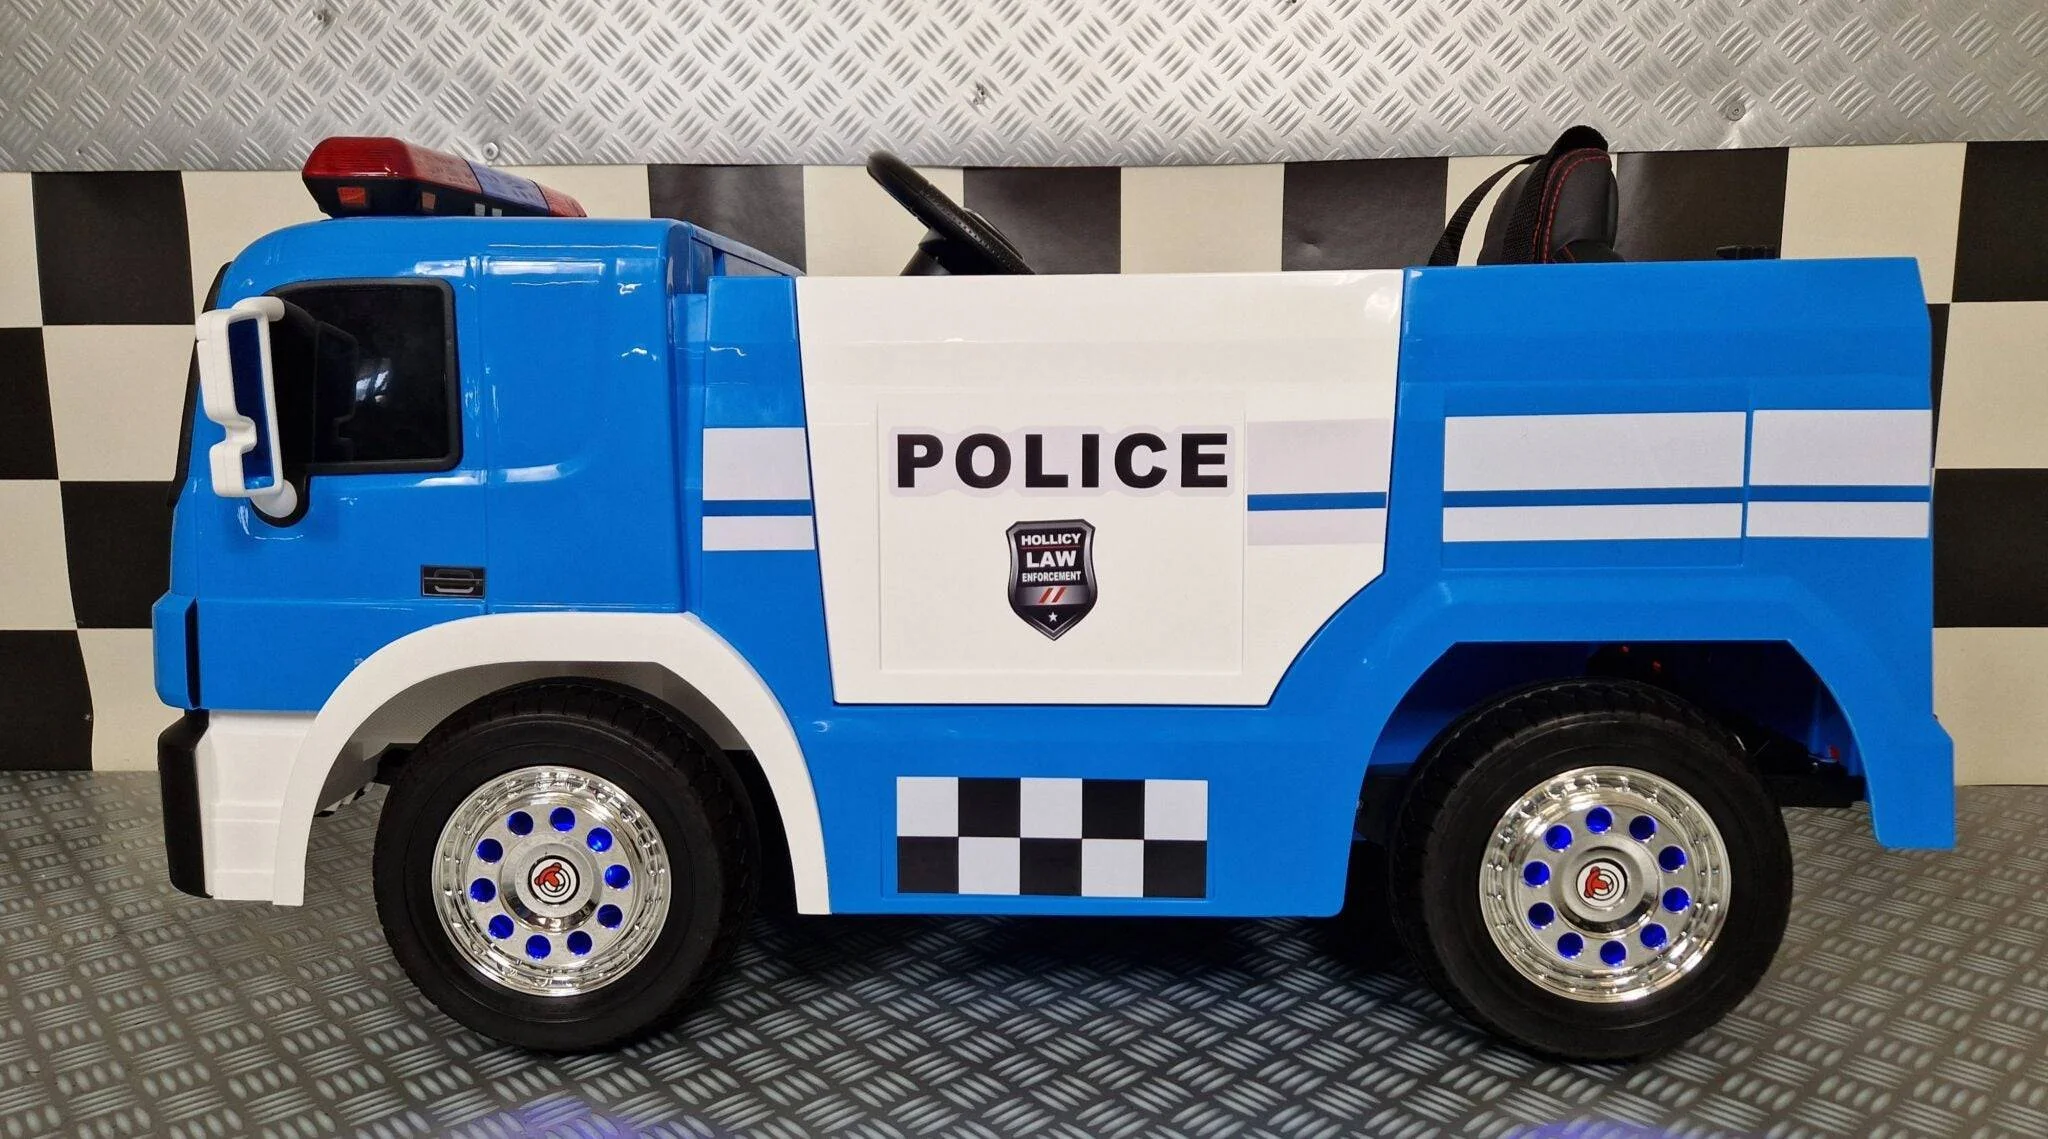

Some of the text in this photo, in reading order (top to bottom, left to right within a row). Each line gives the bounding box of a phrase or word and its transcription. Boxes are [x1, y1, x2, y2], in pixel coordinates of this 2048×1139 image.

[897, 433, 1228, 488] POLICE
[1021, 533, 1081, 546] HOLLICY
[1026, 550, 1077, 568] LAW
[1022, 571, 1082, 582] ENFORCEMENT
